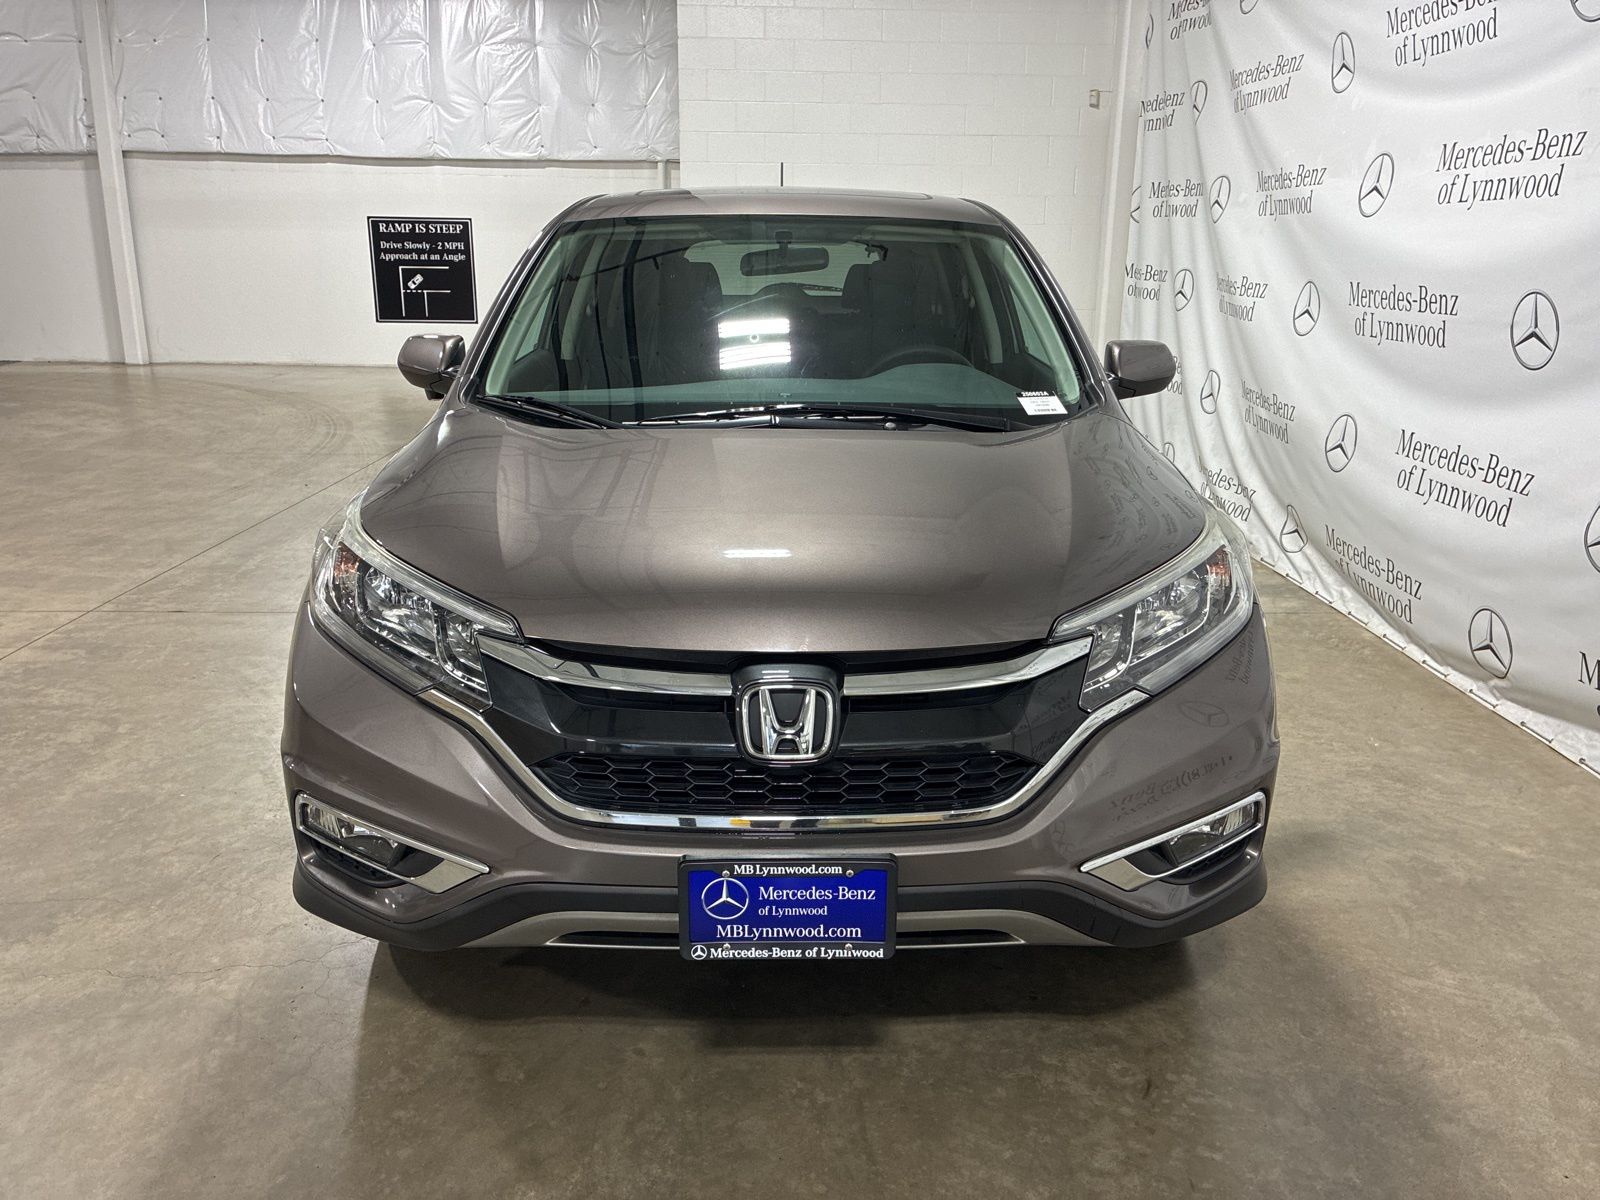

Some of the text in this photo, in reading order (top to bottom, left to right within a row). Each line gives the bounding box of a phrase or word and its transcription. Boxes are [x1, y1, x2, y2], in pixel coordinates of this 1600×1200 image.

[1386, 0, 1498, 38] Mercedes-
[1395, 7, 1498, 67] of Lynnwood
[1229, 54, 1305, 91] Mercedes-Benz
[1240, 77, 1291, 115] Lynnwood
[1435, 128, 1588, 172] Mercedes-Benz
[1256, 164, 1327, 192] Mercedes-Benz
[1437, 163, 1565, 211] of Lynnwood
[1153, 200, 1165, 218] of
[1258, 189, 1313, 221] of Lynnwood
[379, 223, 464, 234] RAMP IS STEEP
[380, 241, 403, 250] Drive
[404, 241, 431, 251] Slowly
[437, 242, 442, 250] 2
[444, 242, 465, 250] MPH
[380, 252, 418, 261] Approach
[420, 252, 428, 260] at
[442, 252, 466, 262] Angle
[1349, 281, 1459, 316] Mercedes-Benz
[1354, 312, 1447, 348] of Lynnwood
[1241, 377, 1296, 422] Mercedes-Benz
[1251, 406, 1289, 445] Lynnwood
[1395, 429, 1535, 497] Mercedes-Benz
[1396, 464, 1513, 528] of Lynnwood
[1325, 524, 1422, 600] Mercedes-Benz
[734, 864, 842, 877] MB Lynnwood.com
[758, 886, 876, 901] Mercedes-Benz
[758, 905, 828, 917] of Lynnwood
[716, 924, 862, 941] MBLynnwood.com
[710, 947, 884, 960] Mercedes-Benz of Lynnwood
